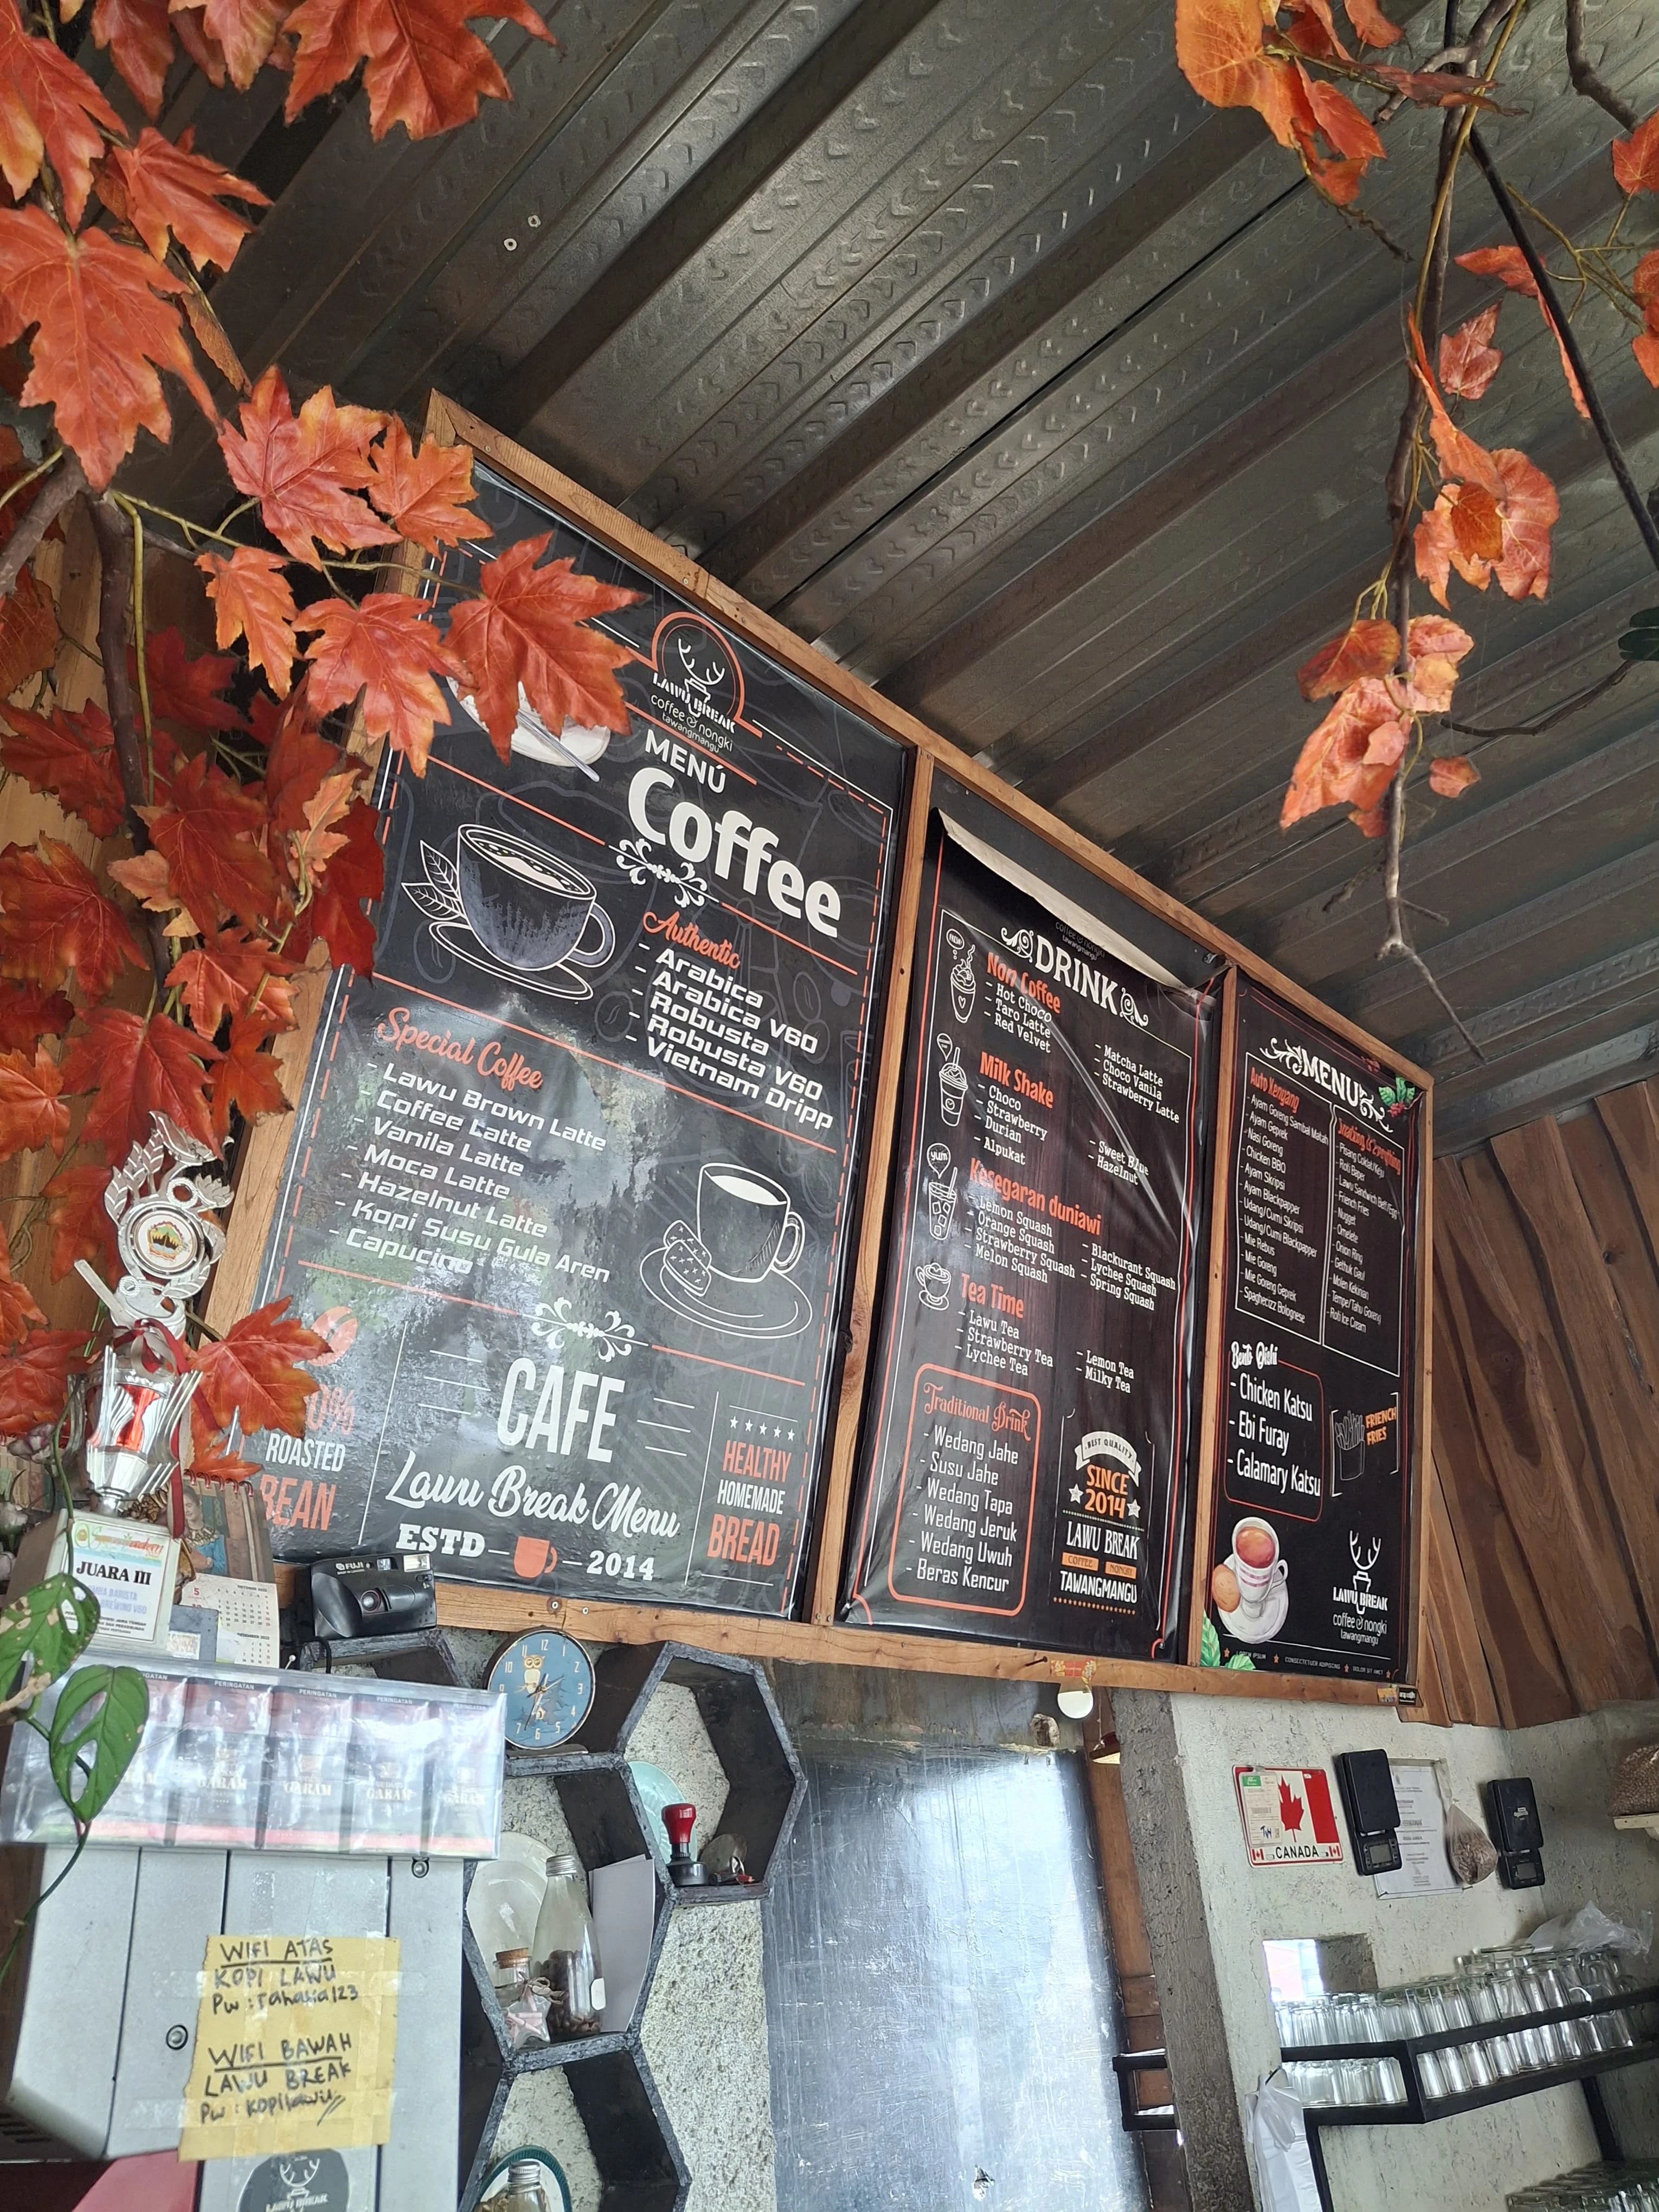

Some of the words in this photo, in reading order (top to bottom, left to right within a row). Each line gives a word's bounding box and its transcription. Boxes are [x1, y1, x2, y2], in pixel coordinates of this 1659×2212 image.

[651, 694, 685, 721] coffee
[699, 723, 734, 751] nongki
[653, 672, 690, 706] LAWU
[690, 698, 736, 734] BREAK
[662, 713, 719, 754] tawangmangu
[645, 729, 726, 793] MENÚ
[628, 767, 840, 938] Coffee
[642, 911, 741, 969] Authentic
[656, 948, 764, 1008] Arabica
[987, 952, 1017, 987] Non
[1020, 972, 1061, 1014] Coffee
[1034, 935, 1118, 1015] DRINK
[653, 973, 761, 1030] Arabica
[770, 1019, 818, 1054] V60
[995, 998, 1020, 1020] Taro
[1023, 1015, 1051, 1039] Latte
[996, 983, 1016, 1000] Hot
[1018, 994, 1052, 1022] Choco
[651, 992, 769, 1056] Robusta
[994, 1014, 1014, 1034] Red
[1017, 1023, 1051, 1053] Velvet
[377, 1007, 474, 1065] Special
[477, 1042, 543, 1091] Coffee
[647, 1014, 767, 1078] Robusta
[775, 1066, 823, 1101] V60
[1104, 1045, 1137, 1072] Matcha
[1139, 1064, 1163, 1087] Latte
[648, 1036, 760, 1099] Vietnam
[765, 1088, 833, 1130] Dripp
[980, 1052, 1010, 1087] Milk
[1013, 1069, 1053, 1109] Shake
[1103, 1059, 1131, 1083] Choco
[1133, 1076, 1162, 1101] Vanila
[1301, 1048, 1361, 1107] MENU
[383, 1063, 456, 1101] Lawu
[462, 1090, 544, 1129] Brown
[549, 1119, 607, 1152] Latte
[989, 1085, 1021, 1110] Choco
[1251, 1095, 1268, 1110] Ayam
[1269, 1105, 1289, 1126] Goreng
[1289, 1116, 1310, 1134] Sambal
[985, 1115, 1021, 1143] Durian
[987, 1101, 1047, 1141] Strawberry
[374, 1116, 454, 1156] Vanila
[460, 1144, 524, 1176] Latte
[983, 1137, 1026, 1165] Alpukat
[1098, 1141, 1126, 1161] Sweet
[1127, 1155, 1148, 1176] Blue
[1246, 1146, 1270, 1166] Chicken
[1271, 1157, 1287, 1173] BBQ
[1248, 1129, 1261, 1143] Nasi
[1262, 1136, 1283, 1157] Goreng
[1097, 1154, 1139, 1185] Hazelnut
[1245, 1163, 1263, 1181] Ayam
[1264, 1173, 1285, 1191] Skripsi
[358, 1172, 481, 1219] Hazelnut
[485, 1206, 548, 1238] Latte
[969, 1158, 1046, 1211] Kesegaran
[1049, 1195, 1102, 1236] duniawi
[980, 1195, 1014, 1220] Lemon
[1017, 1210, 1052, 1237] Squash
[1355, 1199, 1369, 1217] Fries
[346, 1228, 473, 1275] Capucino
[351, 1199, 417, 1231] Kopi
[422, 1218, 492, 1249] Susu
[496, 1238, 550, 1266] Gula
[555, 1254, 610, 1283] Aren
[975, 1228, 1038, 1264] Strawberry
[1040, 1253, 1076, 1278] Squash
[1245, 1232, 1256, 1245] Mie
[1257, 1238, 1275, 1256] Rebus
[1336, 1240, 1351, 1257] Onion
[1352, 1249, 1363, 1265] Ring
[1091, 1243, 1142, 1275] Blackurant
[1145, 1268, 1175, 1290] Squash
[962, 1274, 986, 1305] Tea
[991, 1283, 1024, 1319] Time
[969, 1310, 997, 1332] Lawu
[1001, 1319, 1019, 1339] Tea
[968, 1327, 1032, 1363] Strawberry
[1035, 1348, 1053, 1367] Tea
[1231, 1341, 1253, 1369] Bento
[1256, 1341, 1278, 1369] Oishi
[1085, 1366, 1113, 1388] Milky
[1115, 1376, 1131, 1393] Tea
[1240, 1373, 1280, 1411] Chicken
[1284, 1388, 1313, 1422] Katsu
[304, 1382, 356, 1436] 0%
[497, 1357, 625, 1463] CAFE
[924, 1382, 991, 1424] Traditional
[992, 1401, 1031, 1441] Drink
[1366, 1407, 1397, 1428] FRIENCH
[265, 1433, 345, 1472] ROASTED
[934, 1425, 985, 1459] Wedang
[989, 1443, 1018, 1465] Jahe
[1086, 1438, 1102, 1450] BEST
[1104, 1437, 1133, 1459] QUALITY
[1239, 1411, 1255, 1441] Ebi
[1259, 1417, 1289, 1456] Furay
[1367, 1426, 1387, 1445] FRIES
[723, 1440, 792, 1482] HEALTHY
[930, 1451, 963, 1475] Susu
[967, 1464, 999, 1486] Jahe
[1086, 1464, 1130, 1496] SINCE
[1237, 1449, 1288, 1494] Calamary
[1291, 1464, 1321, 1496] Katsu
[385, 1450, 484, 1509] Lawu
[488, 1464, 590, 1525] Break
[592, 1482, 680, 1538] Menu
[717, 1479, 785, 1515] HOMEMADE
[928, 1477, 979, 1510] Wedang
[983, 1489, 1013, 1516] Tapa
[1084, 1488, 1127, 1519] 2014
[396, 1523, 485, 1558] ESTD
[707, 1514, 780, 1566] BREAD
[924, 1504, 976, 1538] Wedang
[980, 1516, 1018, 1542] Jeruk
[1066, 1522, 1102, 1551] LAWU
[1104, 1528, 1141, 1560] BREAK
[76, 1561, 129, 1581] JUARA
[133, 1570, 152, 1585] III
[587, 1550, 655, 1580] 2014
[917, 1558, 959, 1584] Beras
[962, 1566, 1009, 1592] Kencur
[1068, 1555, 1094, 1568] COFFEE
[1059, 1570, 1137, 1603] TAWANGMANGU
[1333, 1587, 1357, 1605] LAWU
[1360, 1592, 1388, 1611] BREAK
[1333, 1612, 1355, 1629] coffee
[1364, 1619, 1387, 1636] nongki
[1340, 1629, 1378, 1647] tawangmangu
[214, 1681, 254, 1690] PERINGATAN
[299, 1689, 337, 1698] PERINGATAN
[377, 1697, 413, 1705] PERINGATAN
[1275, 1844, 1319, 1859] CANADA
[220, 1941, 269, 1962] WIFI
[285, 1938, 333, 1960] ATAS
[215, 1968, 262, 1988] KOPI
[281, 1965, 336, 1986] LAWU
[209, 2042, 263, 2068] WIFI
[281, 2033, 351, 2060] BAWAH
[205, 2070, 267, 2097] LAWU
[286, 2062, 351, 2090] BREAK
